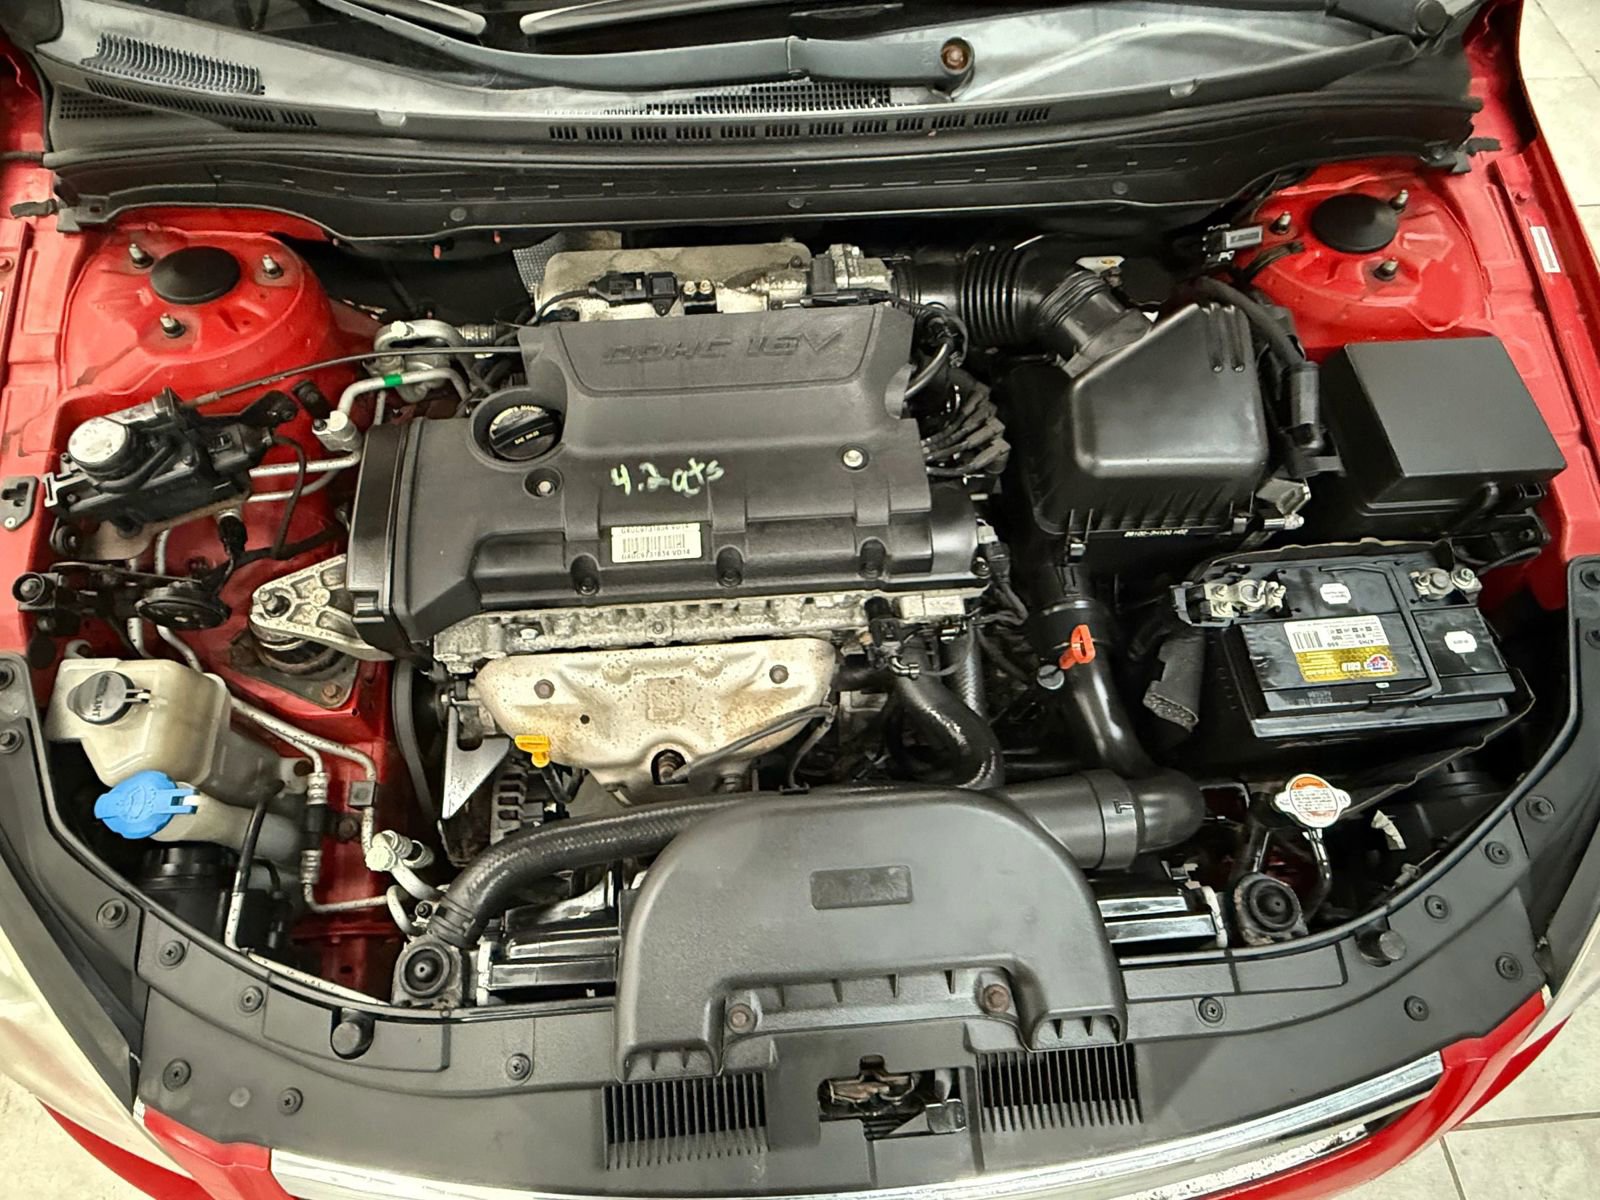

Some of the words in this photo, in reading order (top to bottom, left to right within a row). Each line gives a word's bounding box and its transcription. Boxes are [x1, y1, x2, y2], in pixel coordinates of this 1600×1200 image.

[602, 336, 732, 365] DOHC
[745, 328, 844, 358] 16V
[610, 461, 670, 496] 4.2
